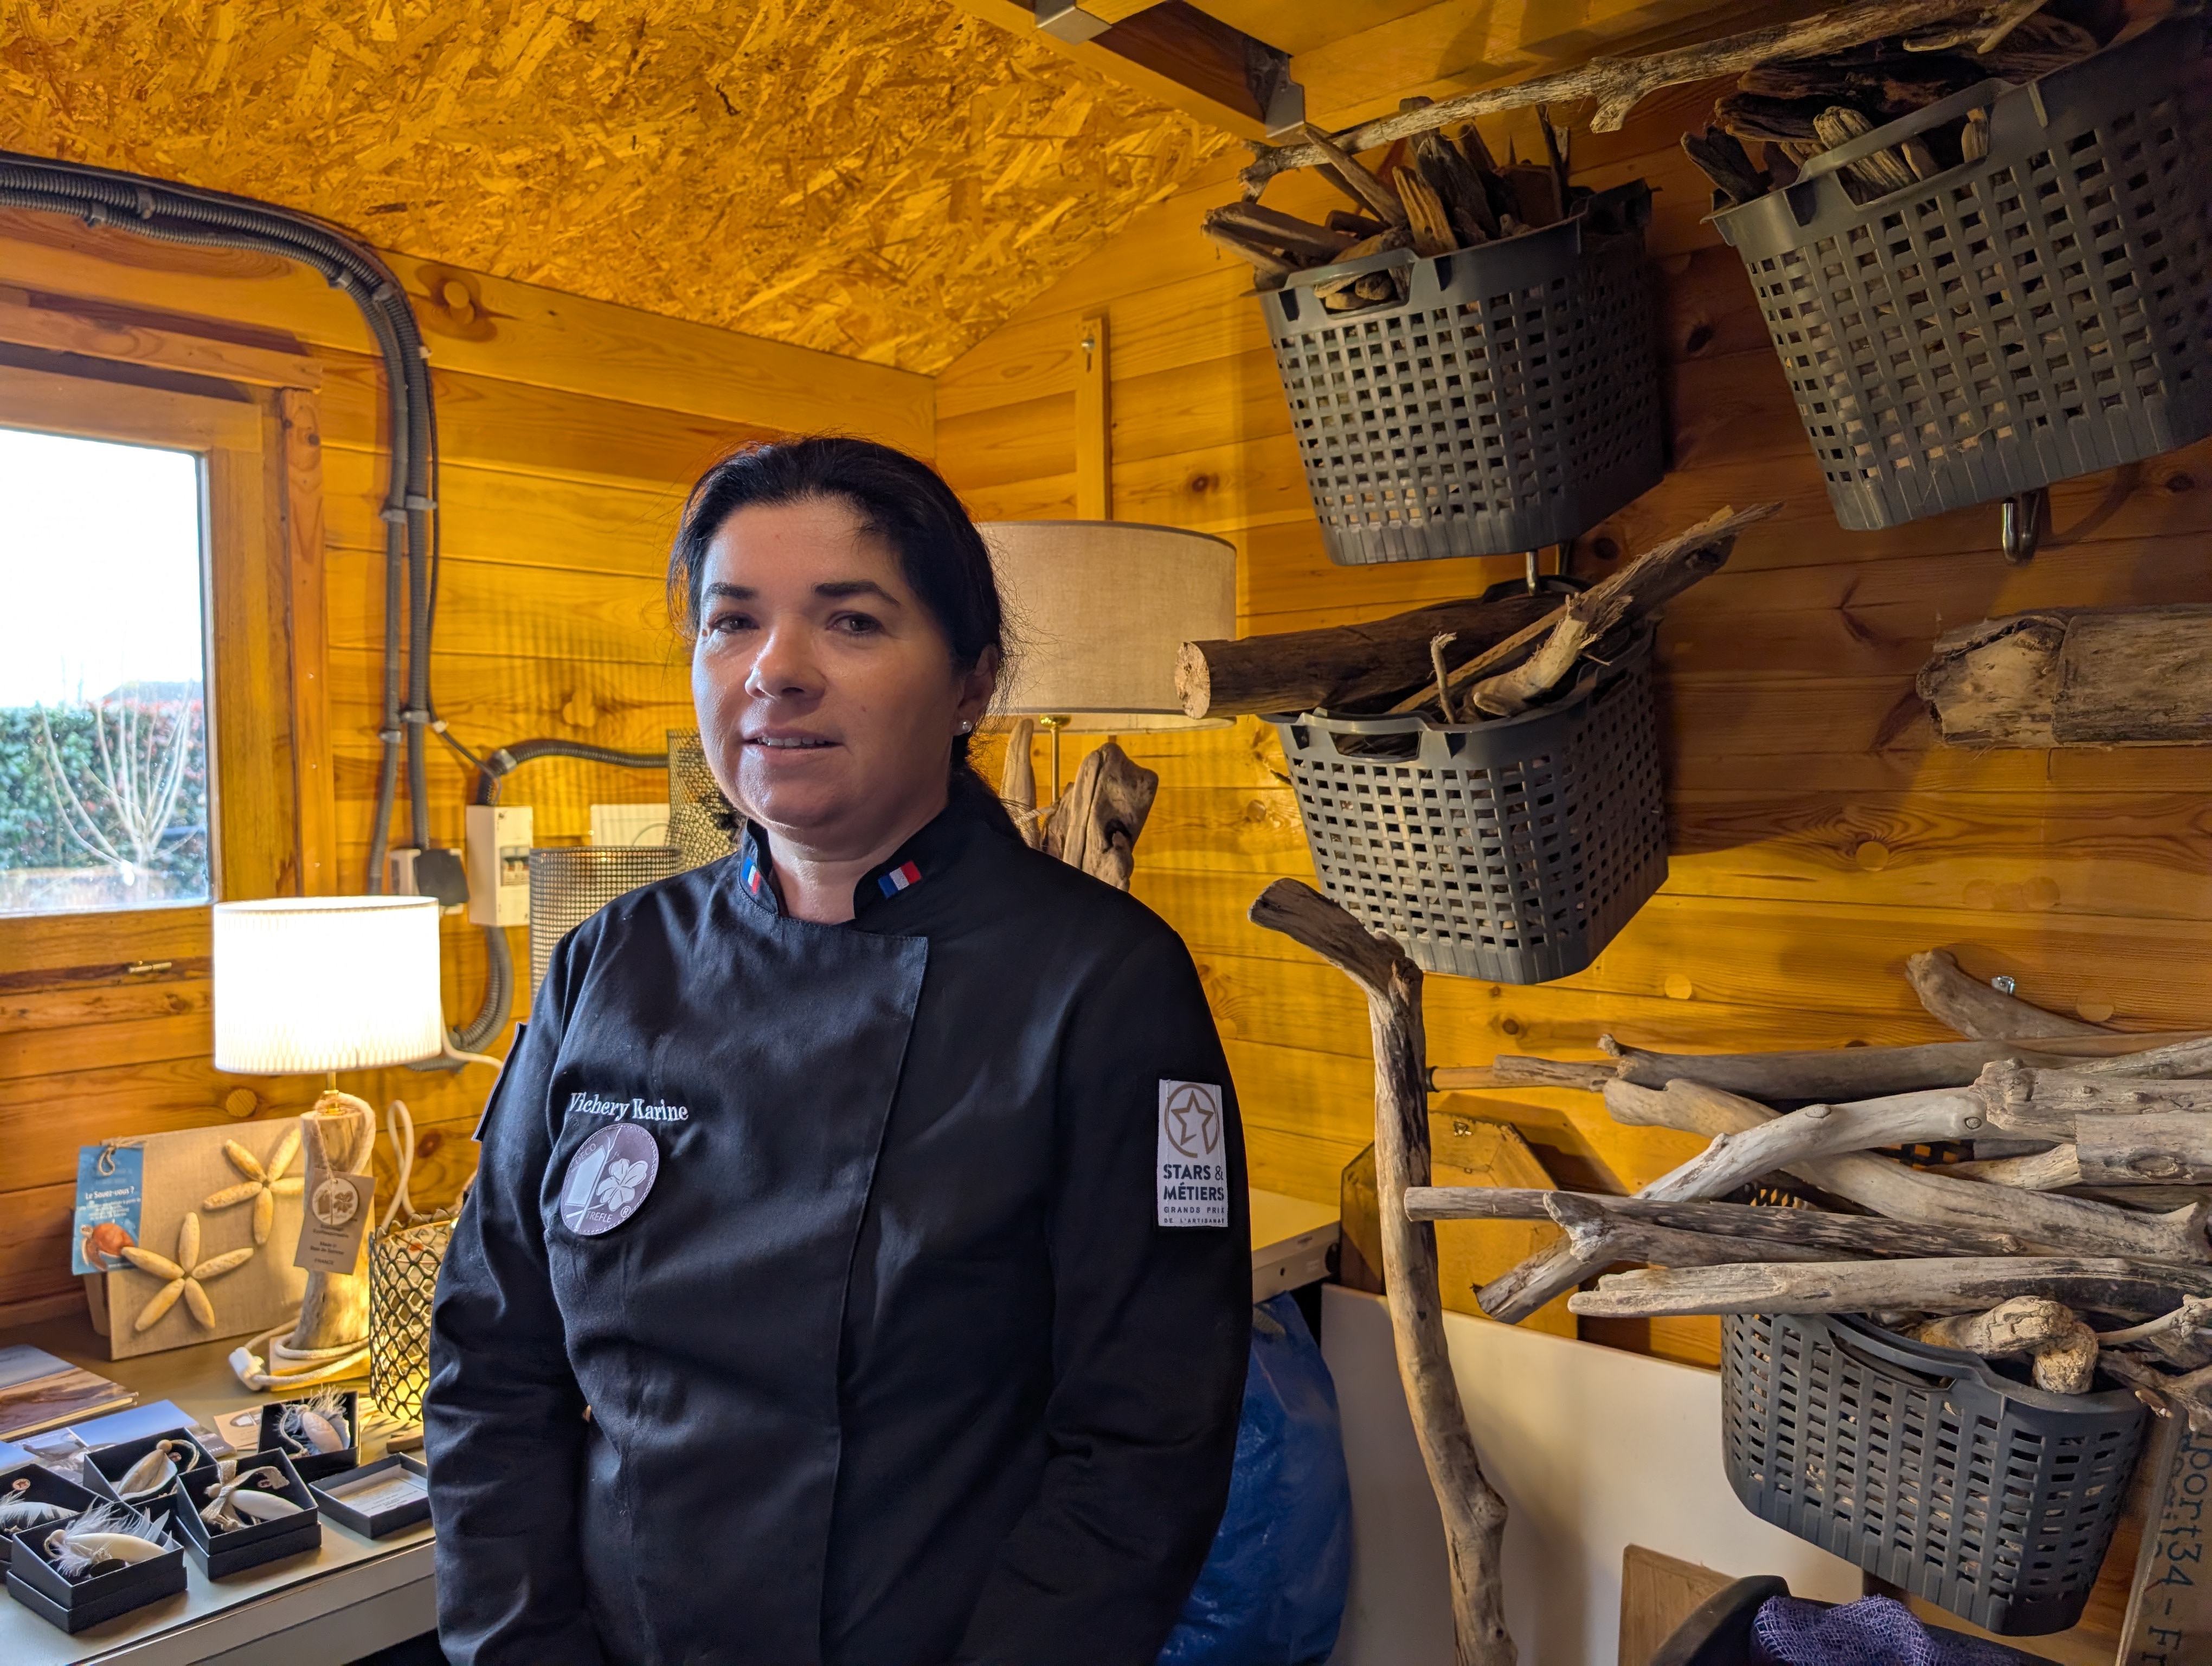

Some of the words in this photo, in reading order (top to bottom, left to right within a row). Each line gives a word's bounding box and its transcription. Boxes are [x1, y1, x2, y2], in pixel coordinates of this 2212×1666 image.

[569, 1091, 630, 1122] Vichery
[632, 1098, 689, 1121] Karine
[575, 1143, 596, 1164] DECO
[1163, 1164, 1211, 1180] STARS
[1215, 1165, 1224, 1180] &
[1163, 1182, 1224, 1201] MÉTIERS
[586, 1210, 613, 1223] TREFLE
